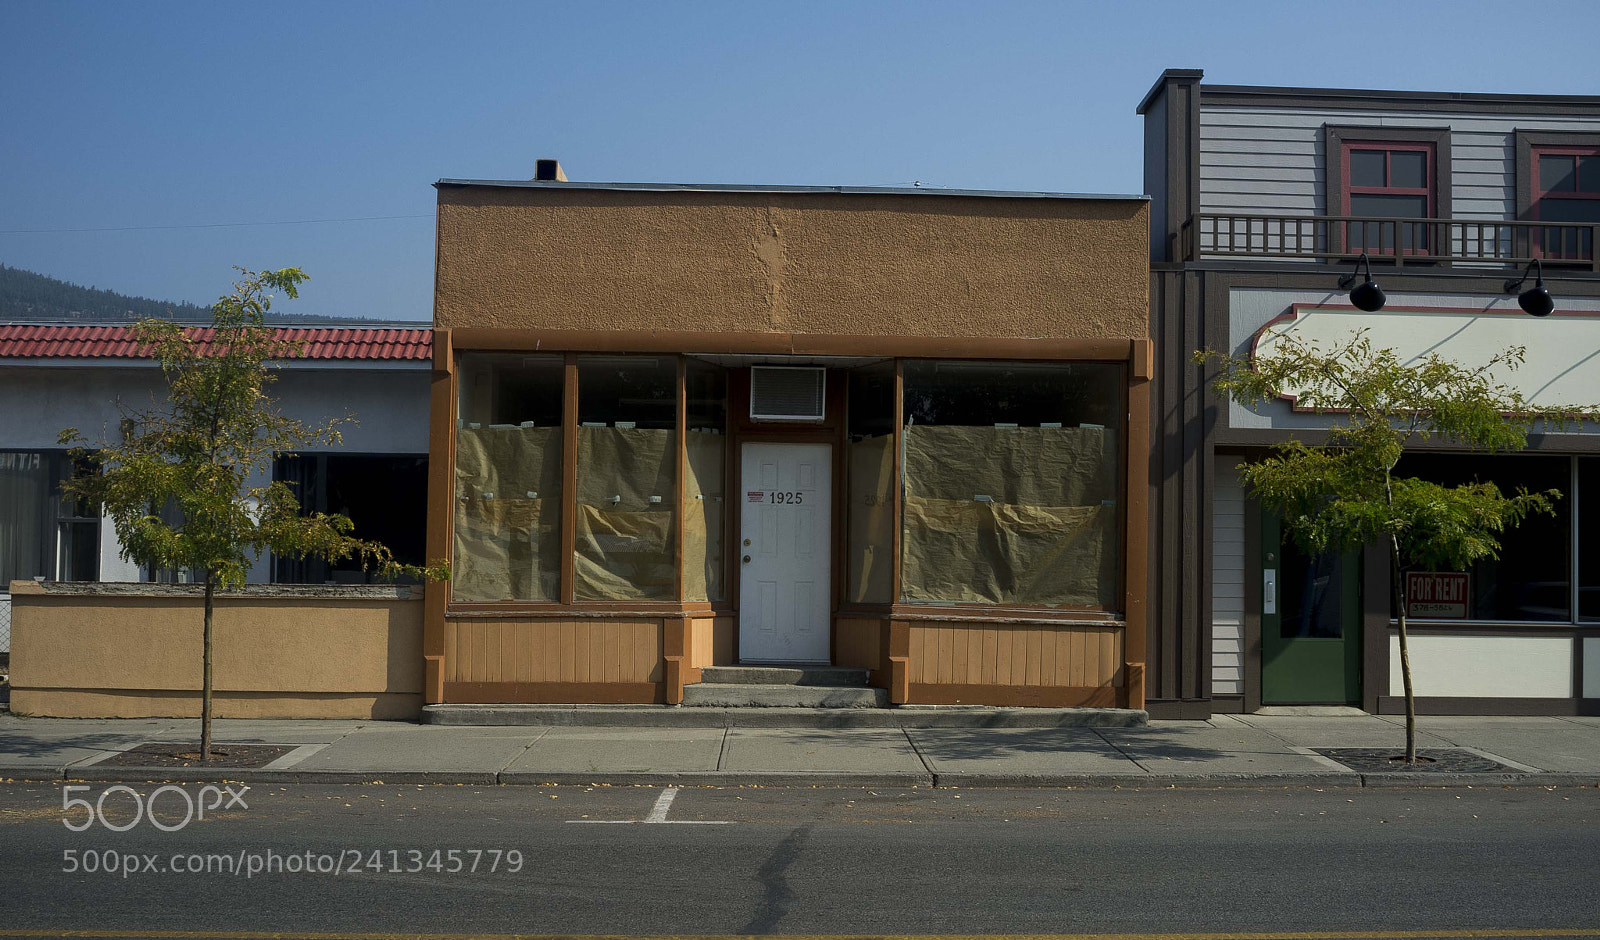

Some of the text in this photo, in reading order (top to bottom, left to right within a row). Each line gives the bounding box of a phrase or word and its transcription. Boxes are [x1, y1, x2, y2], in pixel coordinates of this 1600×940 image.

[769, 491, 803, 505] 1925
[1410, 576, 1465, 601] FOR RENT
